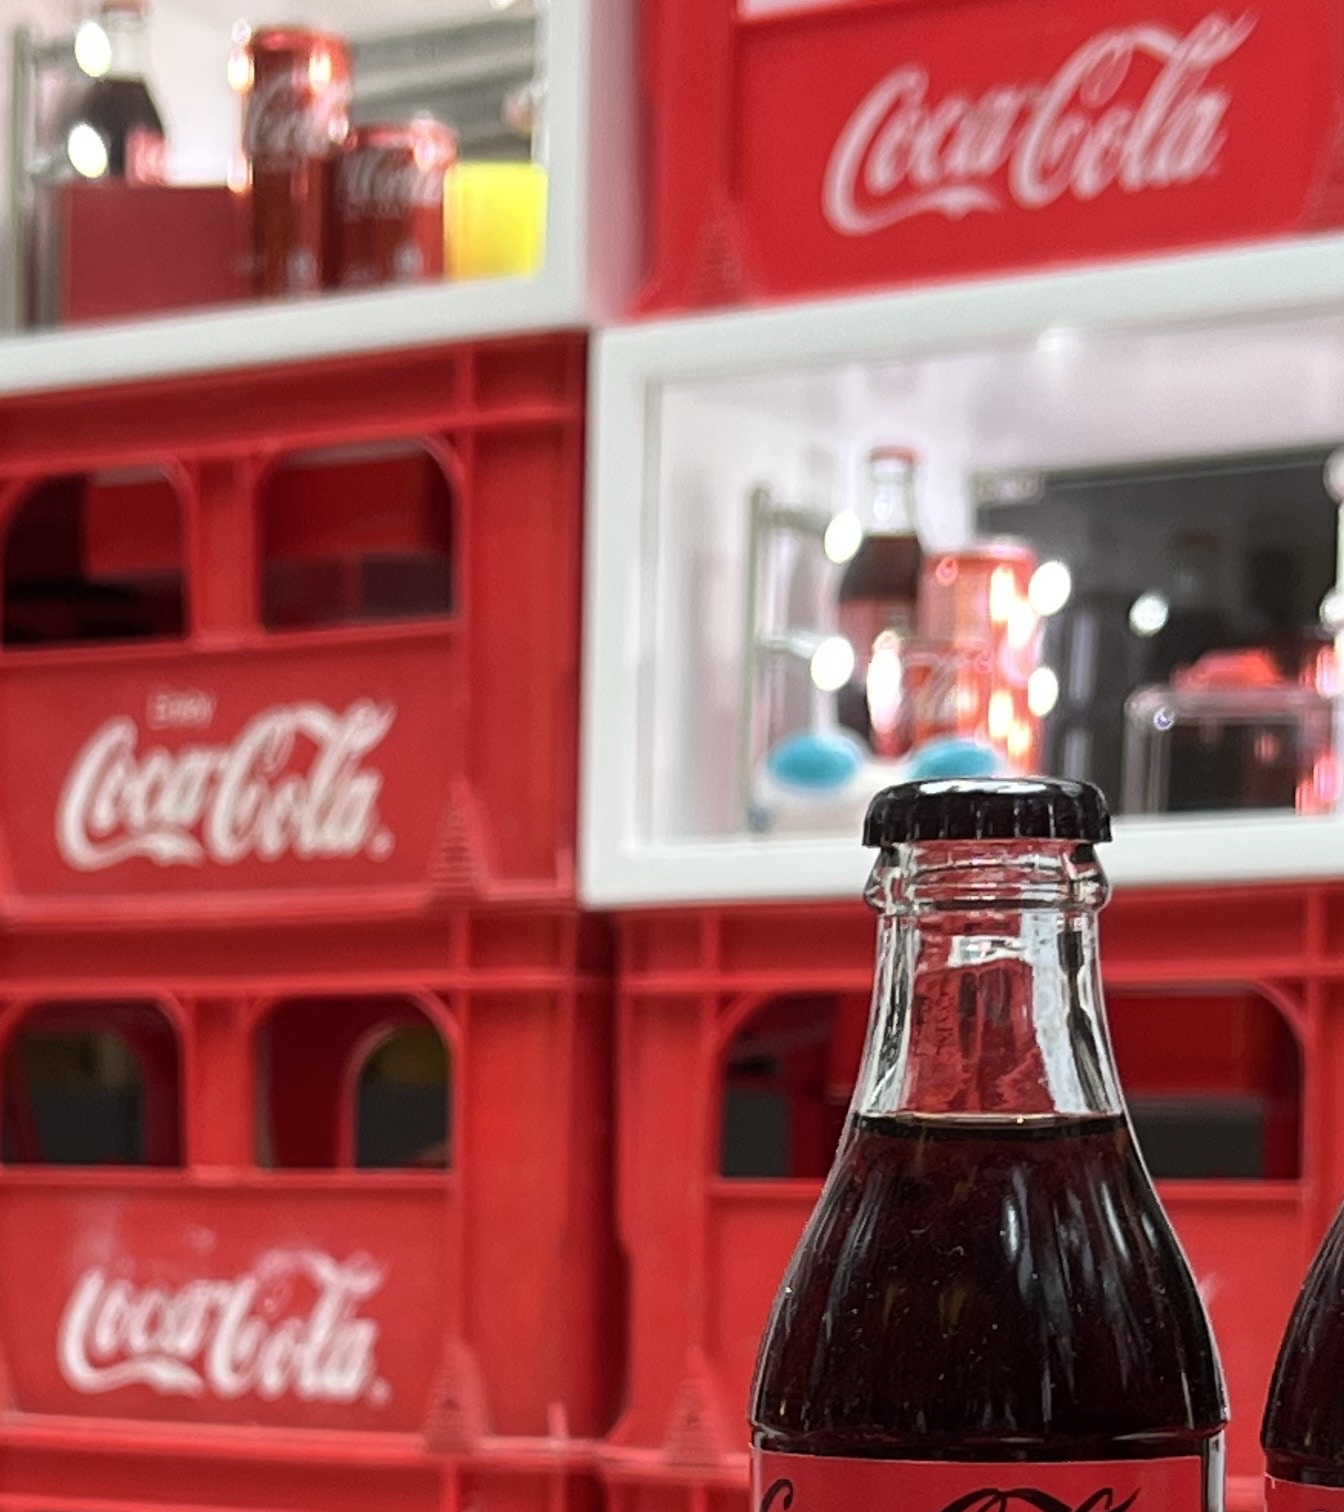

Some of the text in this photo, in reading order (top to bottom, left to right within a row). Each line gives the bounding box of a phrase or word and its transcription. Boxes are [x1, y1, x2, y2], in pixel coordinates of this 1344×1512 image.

[822, 11, 1256, 238] Coca-Cola
[57, 697, 386, 870] Coca-Cola
[57, 1249, 384, 1402] Coca-Cola
